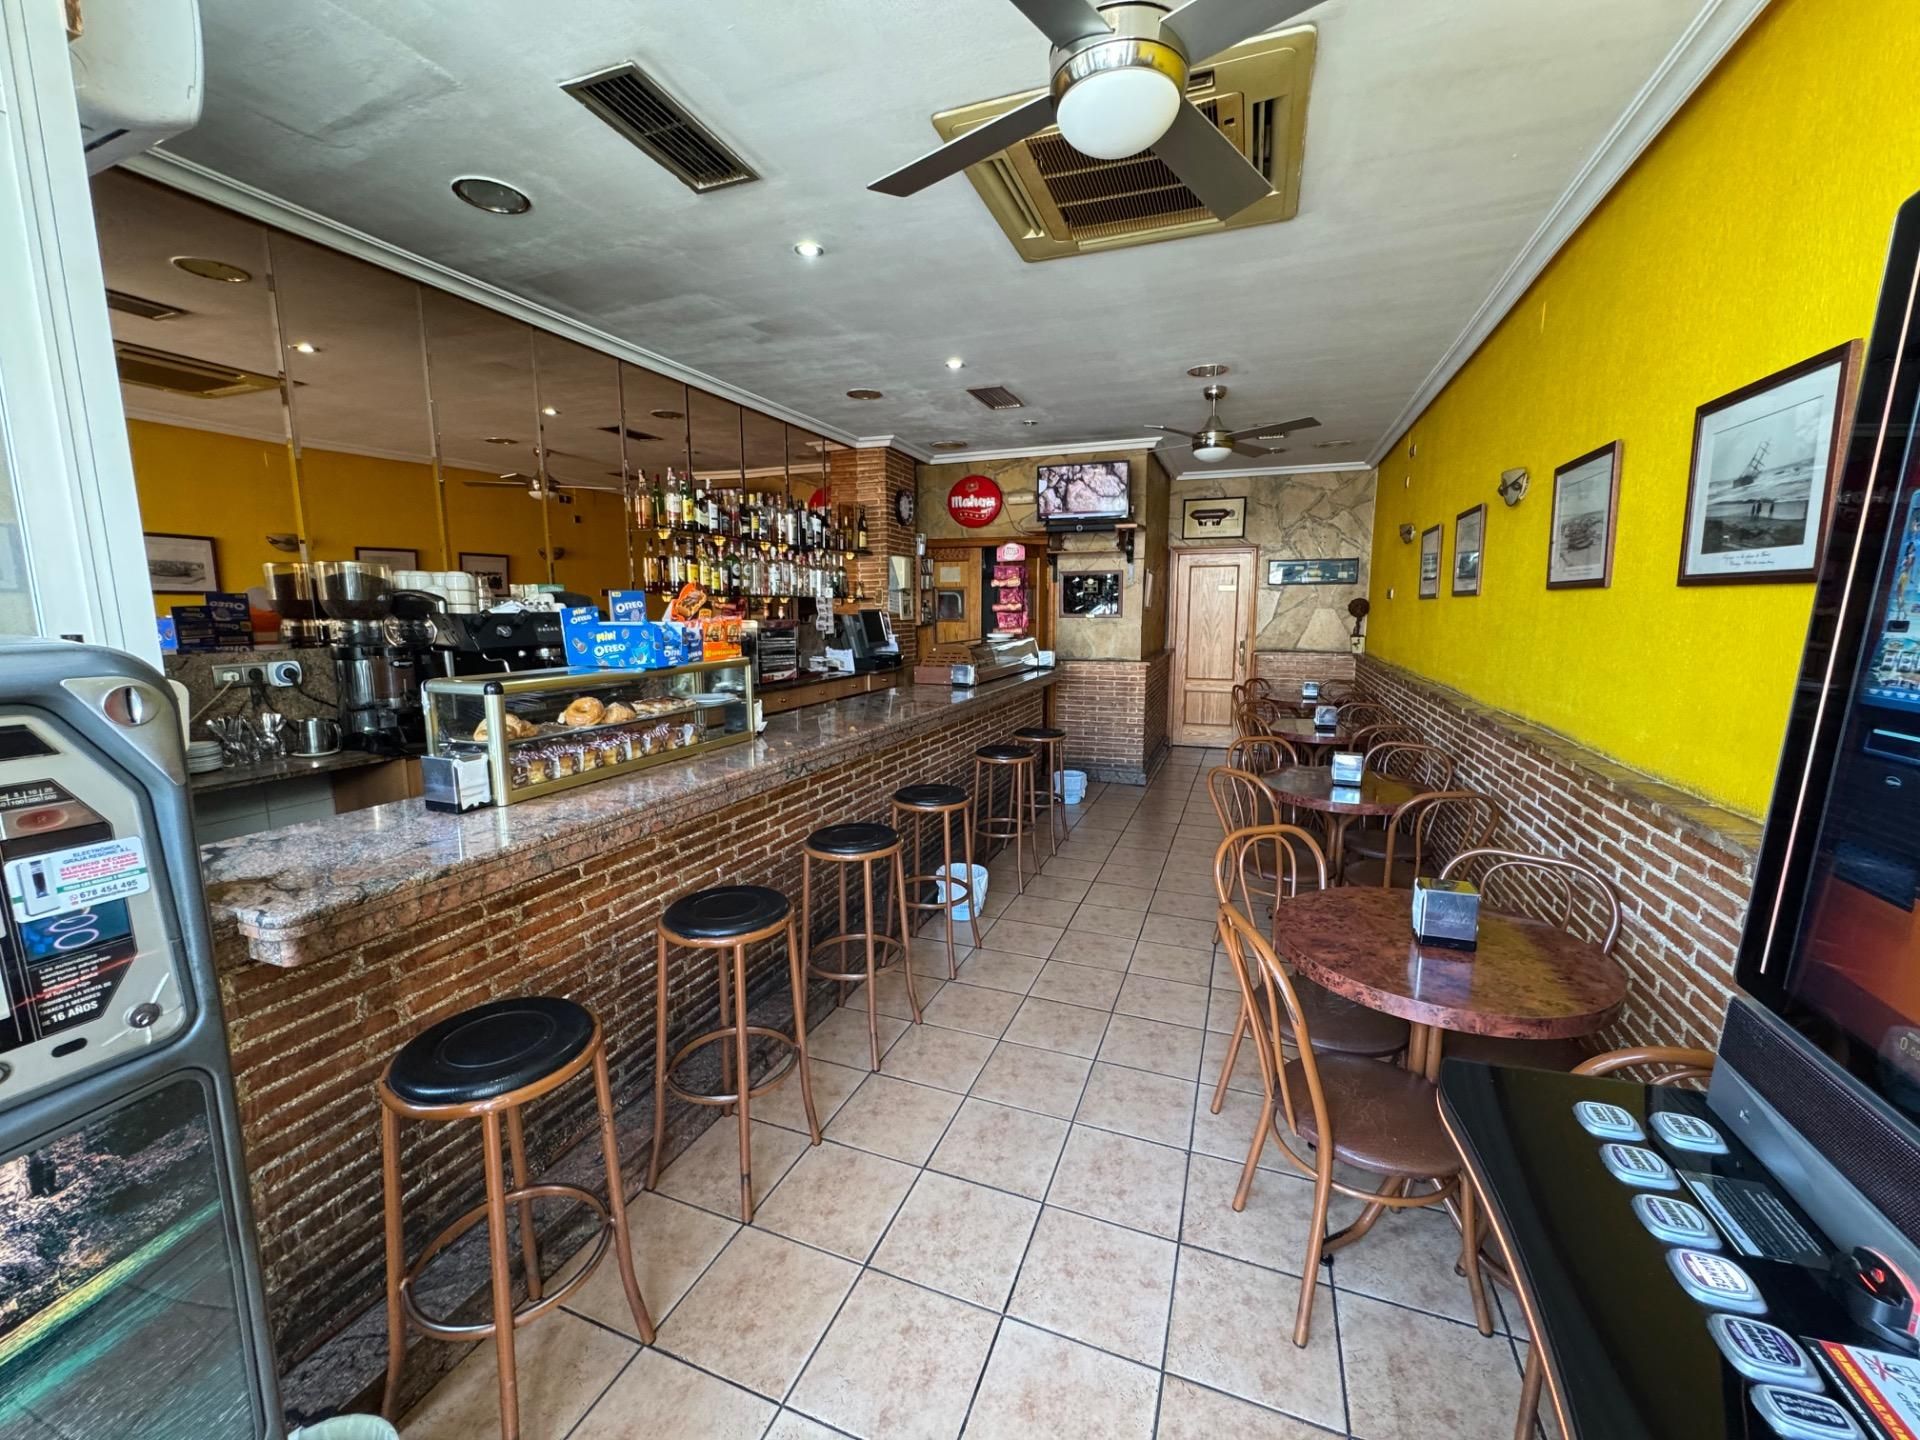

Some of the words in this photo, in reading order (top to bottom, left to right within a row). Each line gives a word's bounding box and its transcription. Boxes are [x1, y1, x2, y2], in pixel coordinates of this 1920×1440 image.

[616, 600, 644, 614] OREO
[570, 614, 592, 624] OREO
[594, 644, 626, 657] OREO
[59, 860, 100, 873] SERVICIO
[102, 852, 137, 864] TÉCNICO
[101, 885, 118, 894] 454
[121, 880, 138, 889] 495
[57, 972, 80, 982] fumar
[53, 986, 76, 998] futuro
[77, 980, 92, 990] hijo
[74, 990, 82, 998] LA
[83, 984, 102, 995] VENTA
[40, 1004, 64, 1016] TABACO
[72, 992, 102, 1005] MENORES
[51, 1011, 66, 1023] 16
[68, 1000, 98, 1018] AÑOS
[1694, 1256, 1730, 1289] AVANCE
[1738, 1322, 1776, 1361] AVANCES
[1754, 1326, 1792, 1364] AUTO
